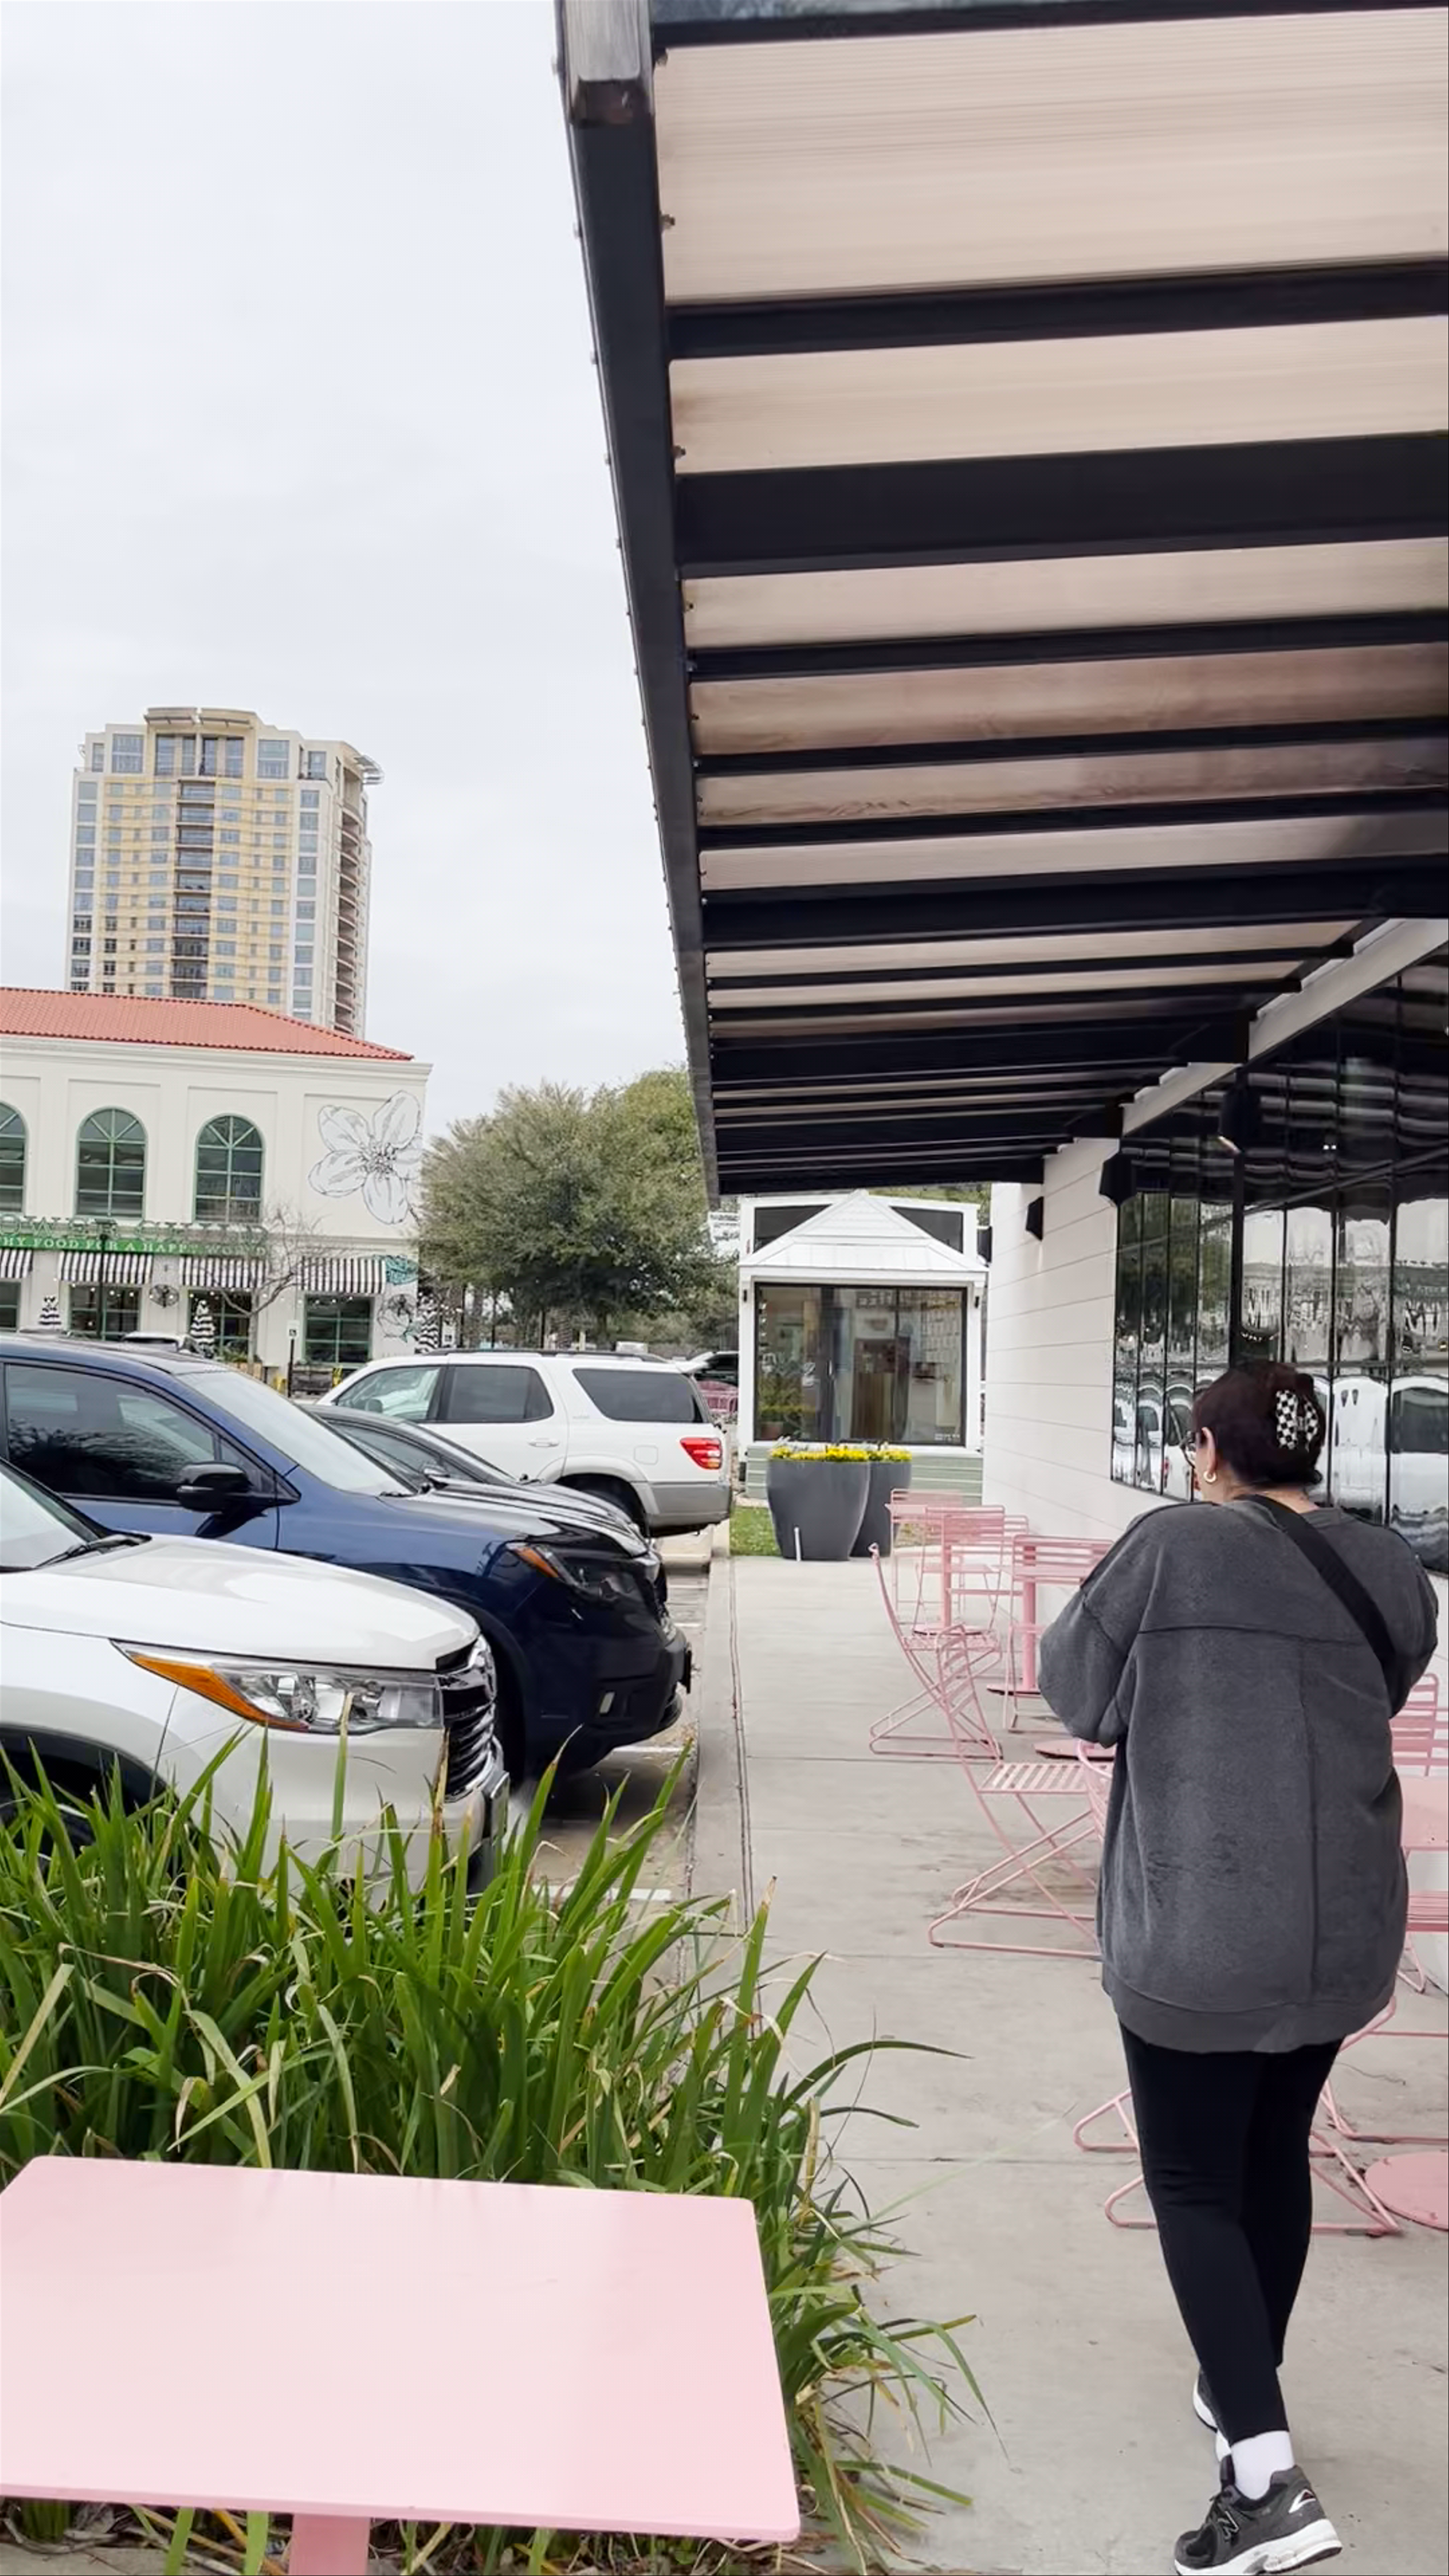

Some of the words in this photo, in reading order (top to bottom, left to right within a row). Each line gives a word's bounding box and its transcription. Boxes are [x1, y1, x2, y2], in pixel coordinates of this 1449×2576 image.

[0, 1236, 26, 1247] HY
[34, 1237, 79, 1249] FOOD
[124, 1242, 136, 1252] A
[205, 1244, 266, 1257] WORD
